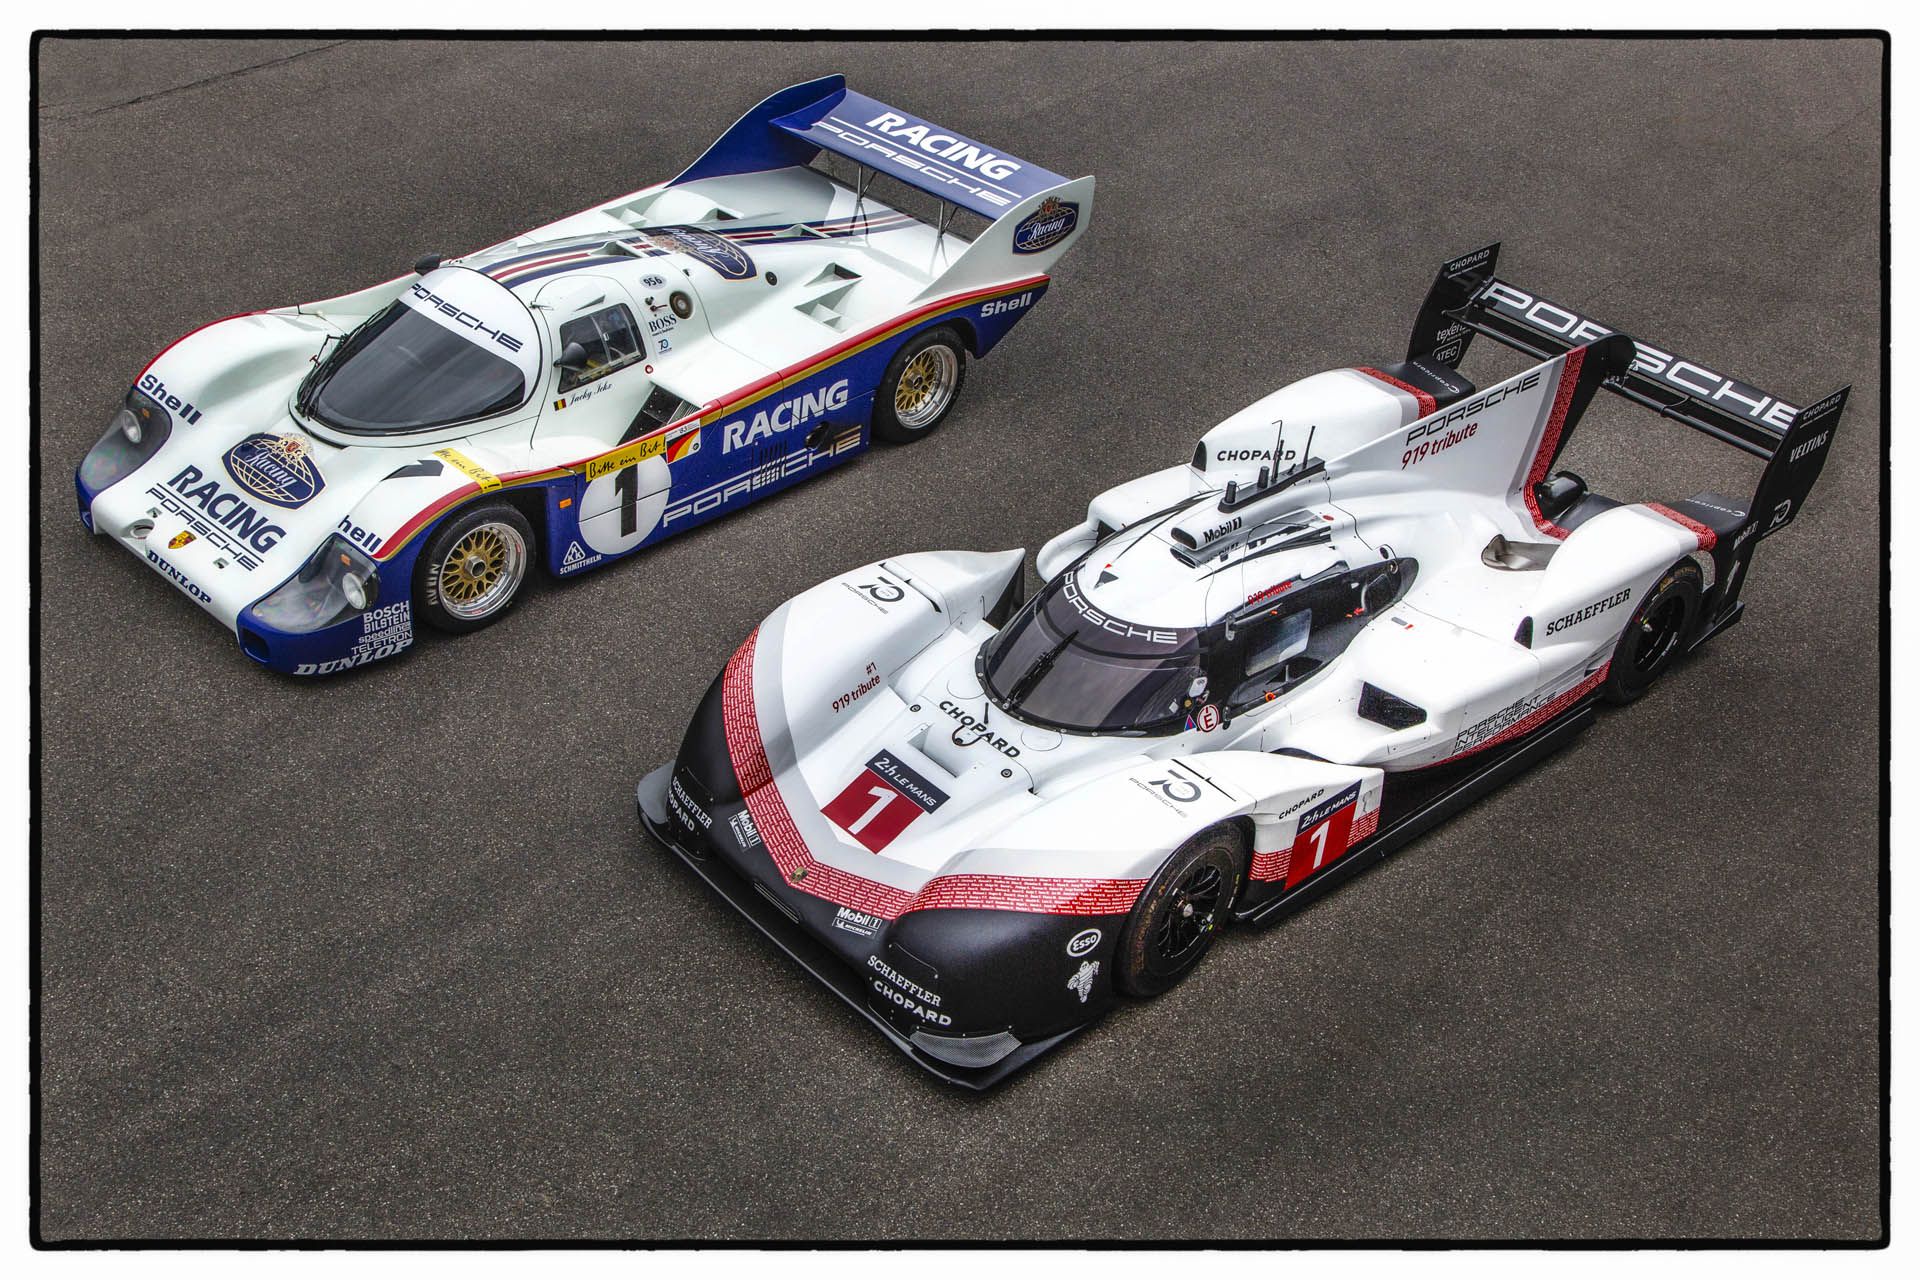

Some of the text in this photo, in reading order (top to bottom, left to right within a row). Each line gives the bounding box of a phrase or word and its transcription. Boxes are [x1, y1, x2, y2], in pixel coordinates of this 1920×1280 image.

[812, 121, 1012, 207] PORSCHE
[866, 111, 1022, 181] RACING
[1027, 217, 1066, 241] Racing
[643, 276, 663, 287] 956
[1450, 250, 1490, 272] CHOPARD
[411, 283, 524, 353] PORSCHE
[648, 313, 677, 333] BOSS
[981, 293, 1032, 318] Shell
[140, 373, 203, 426] Shell
[721, 378, 849, 456] RACING
[1406, 371, 1541, 447] PORSCHE
[245, 447, 299, 488] Racing
[589, 436, 667, 479] Bitte ein Bit!
[1401, 422, 1479, 471] 919 tribute
[1789, 429, 1830, 464] VELTINS
[615, 463, 639, 538] 1
[663, 431, 862, 529] PORSCHE
[144, 487, 259, 572] PORSCHE
[166, 464, 288, 555] RACING
[337, 514, 383, 554] hell
[1203, 520, 1233, 543] Mobil
[147, 549, 213, 605] DUNLOP
[559, 553, 602, 575] SCHMITTHELM
[362, 600, 410, 624] BOSCH
[363, 610, 411, 635] BILSTEIN
[1062, 570, 1178, 646] PORSCHE
[1545, 587, 1632, 637] SCHAEFFLER
[292, 638, 414, 676] DUNLOP
[351, 630, 413, 655] TELETRON
[866, 661, 877, 676] #1
[832, 675, 881, 713] 919 tribute
[939, 700, 1021, 758] CHOPARD
[1456, 697, 1525, 741] PORSCHE
[847, 785, 899, 835] 1
[905, 782, 937, 807] MANS
[1278, 788, 1325, 820] CHOPARD
[1330, 790, 1358, 812] MANS
[737, 810, 759, 838] Mobil
[1310, 819, 1331, 870] 1
[837, 906, 870, 926] Mobil
[866, 955, 942, 1007] SCHAEFFLER
[873, 980, 952, 1027] CHOPARD
